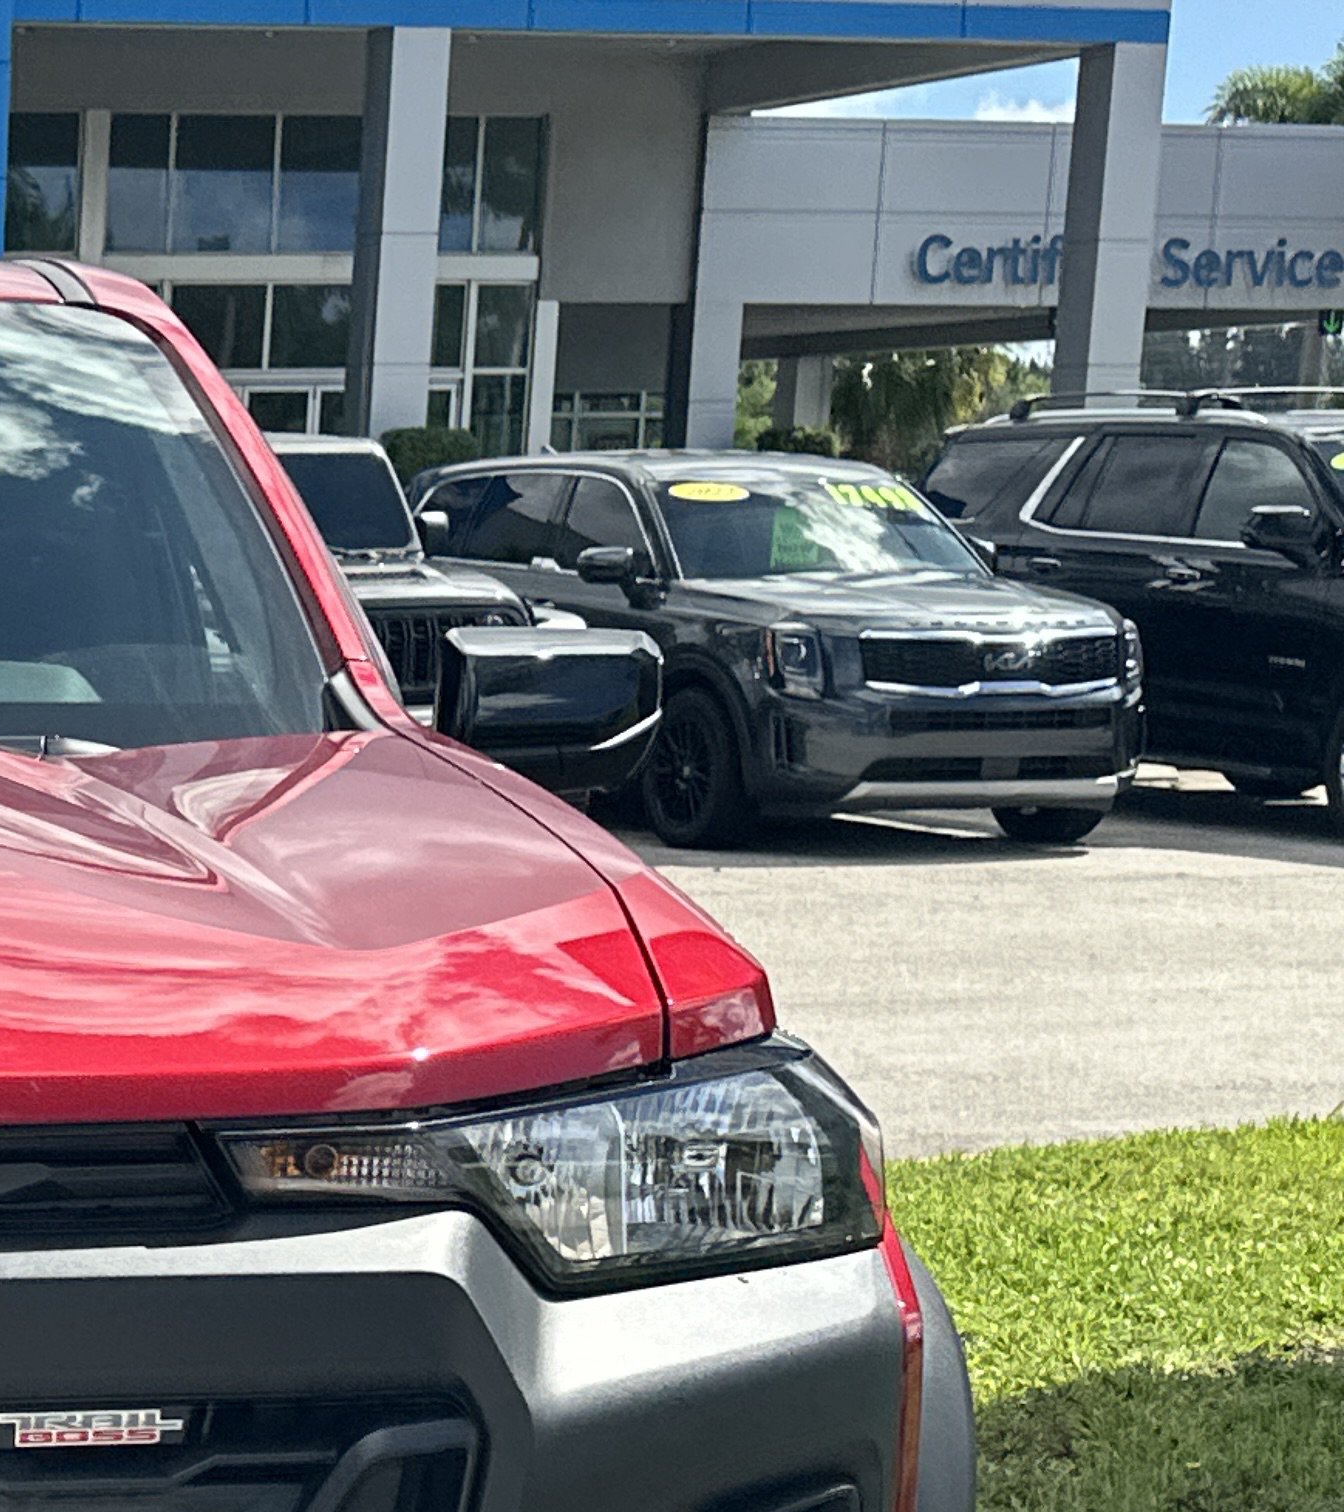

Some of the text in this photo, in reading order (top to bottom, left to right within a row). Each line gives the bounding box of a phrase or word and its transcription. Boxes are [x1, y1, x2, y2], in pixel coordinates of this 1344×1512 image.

[916, 234, 1343, 290] Certif Service
[16, 1428, 161, 1447] BOSS
